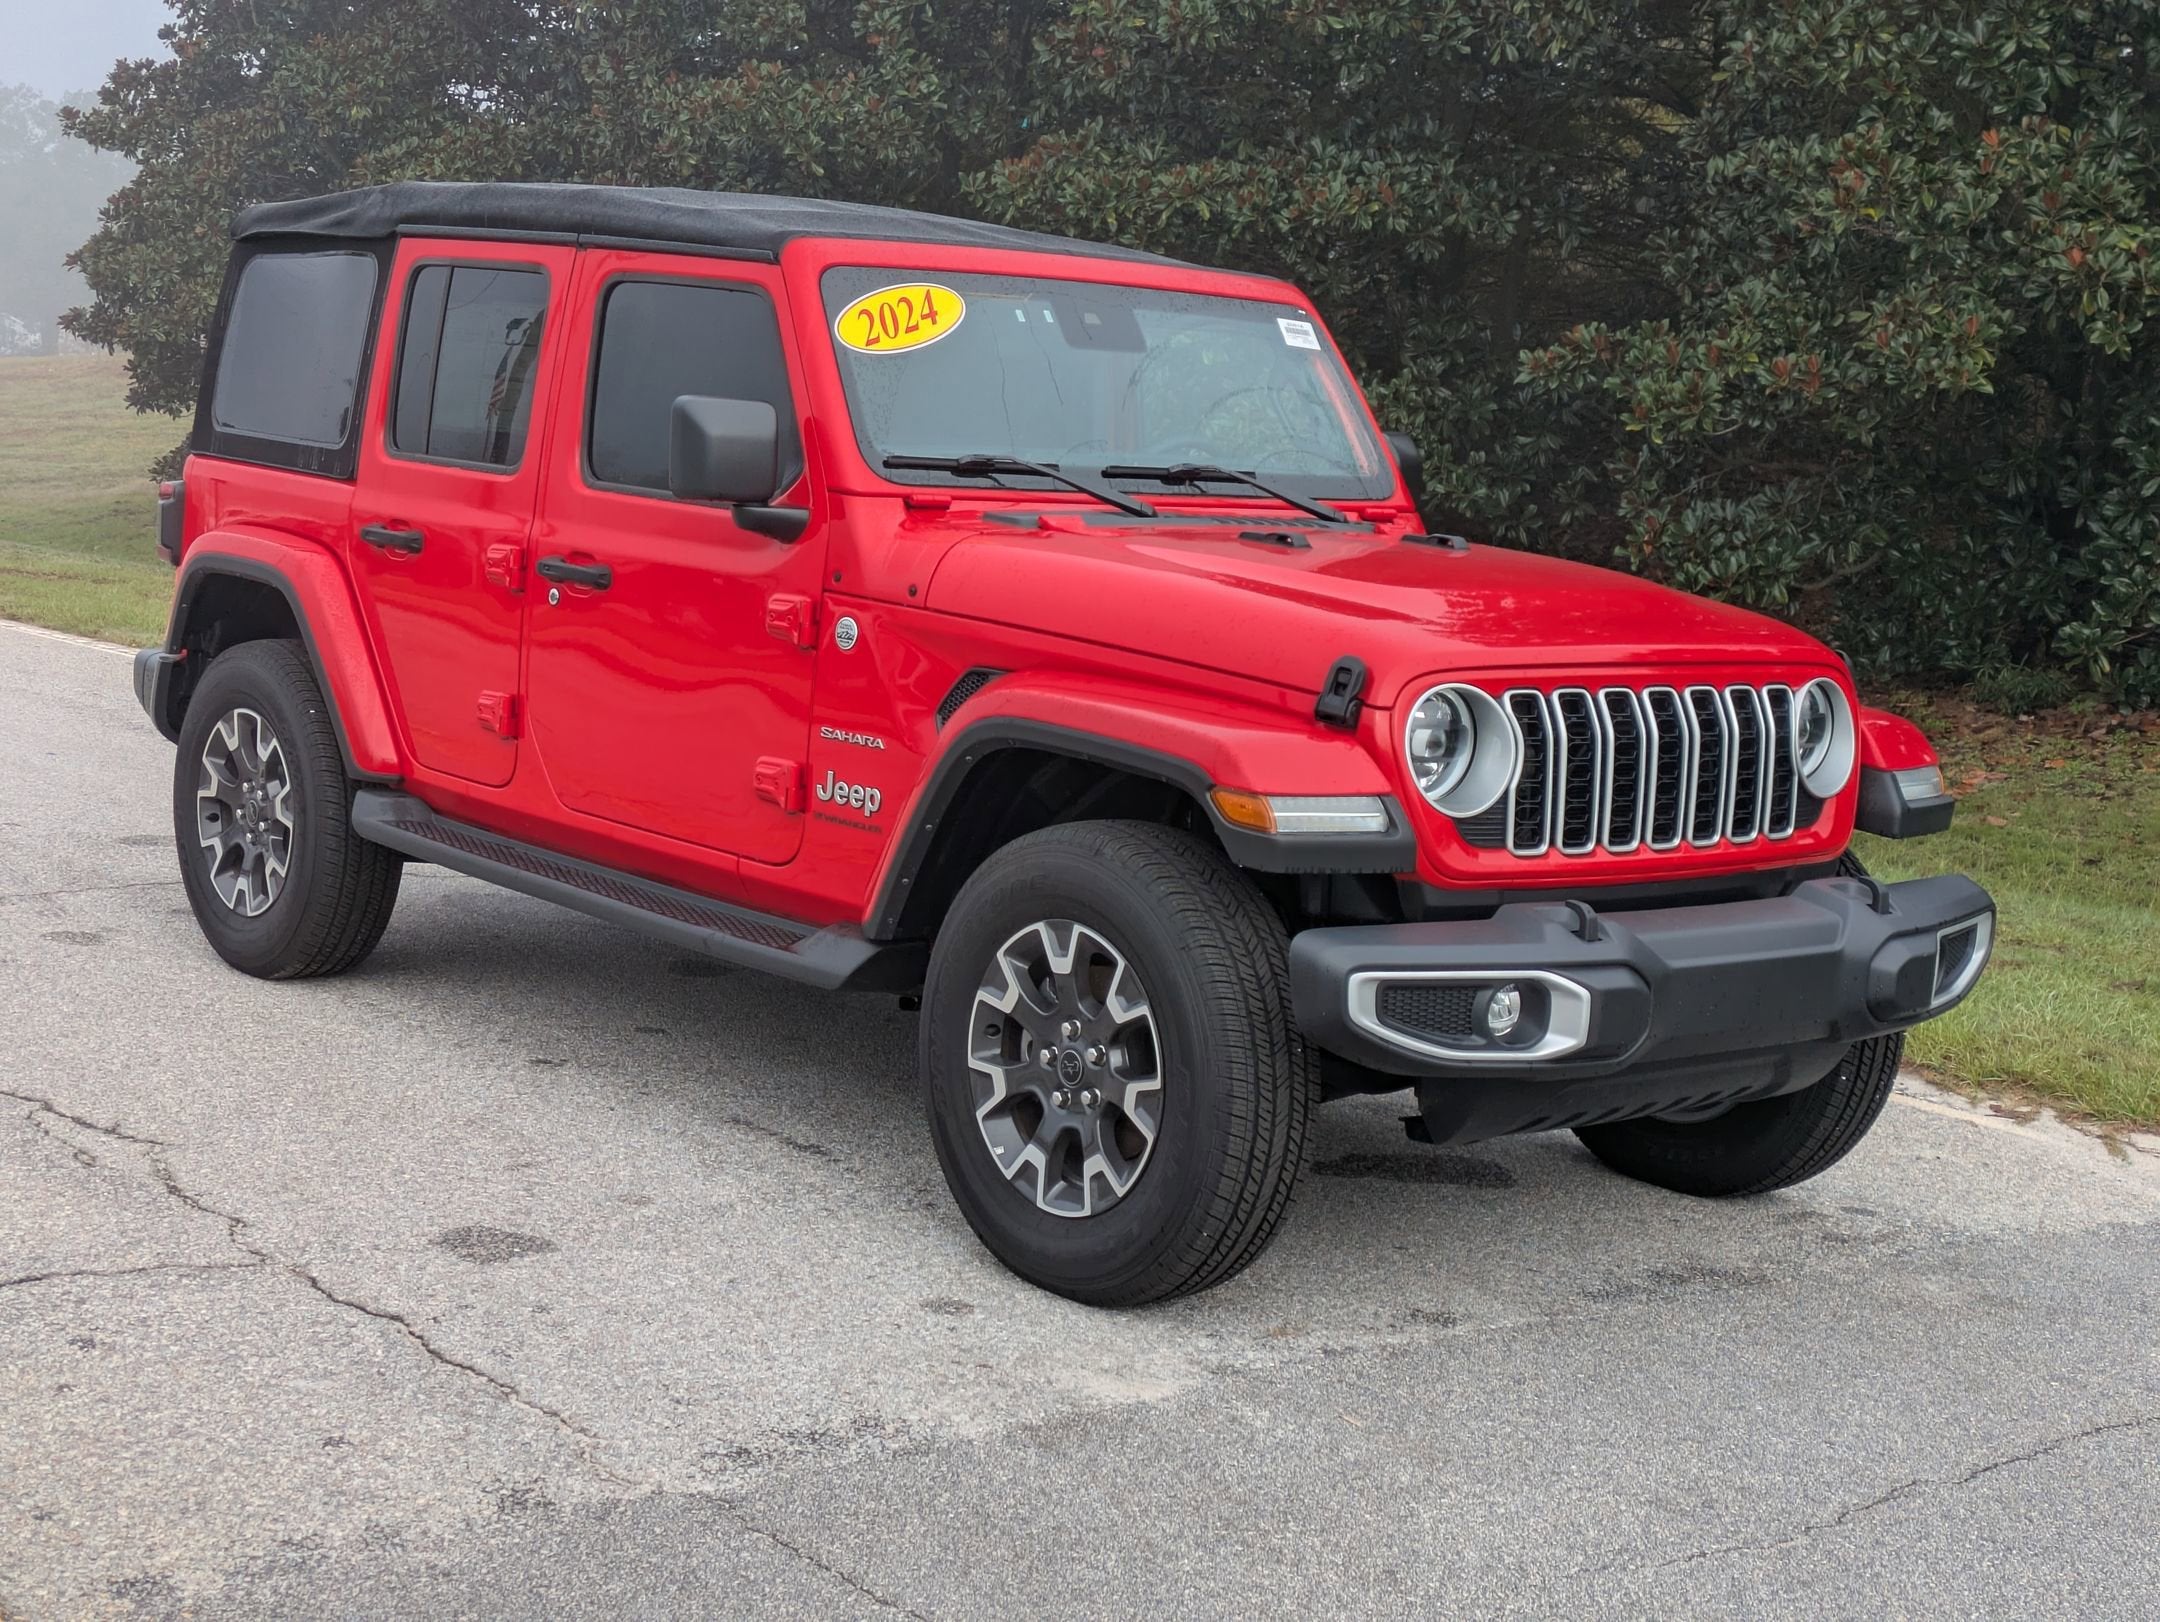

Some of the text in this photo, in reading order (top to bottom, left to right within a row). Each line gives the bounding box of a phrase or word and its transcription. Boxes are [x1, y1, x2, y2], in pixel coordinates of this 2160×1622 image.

[857, 288, 938, 347] 2024
[820, 726, 885, 749] SAHARA
[816, 770, 881, 817] Jeep
